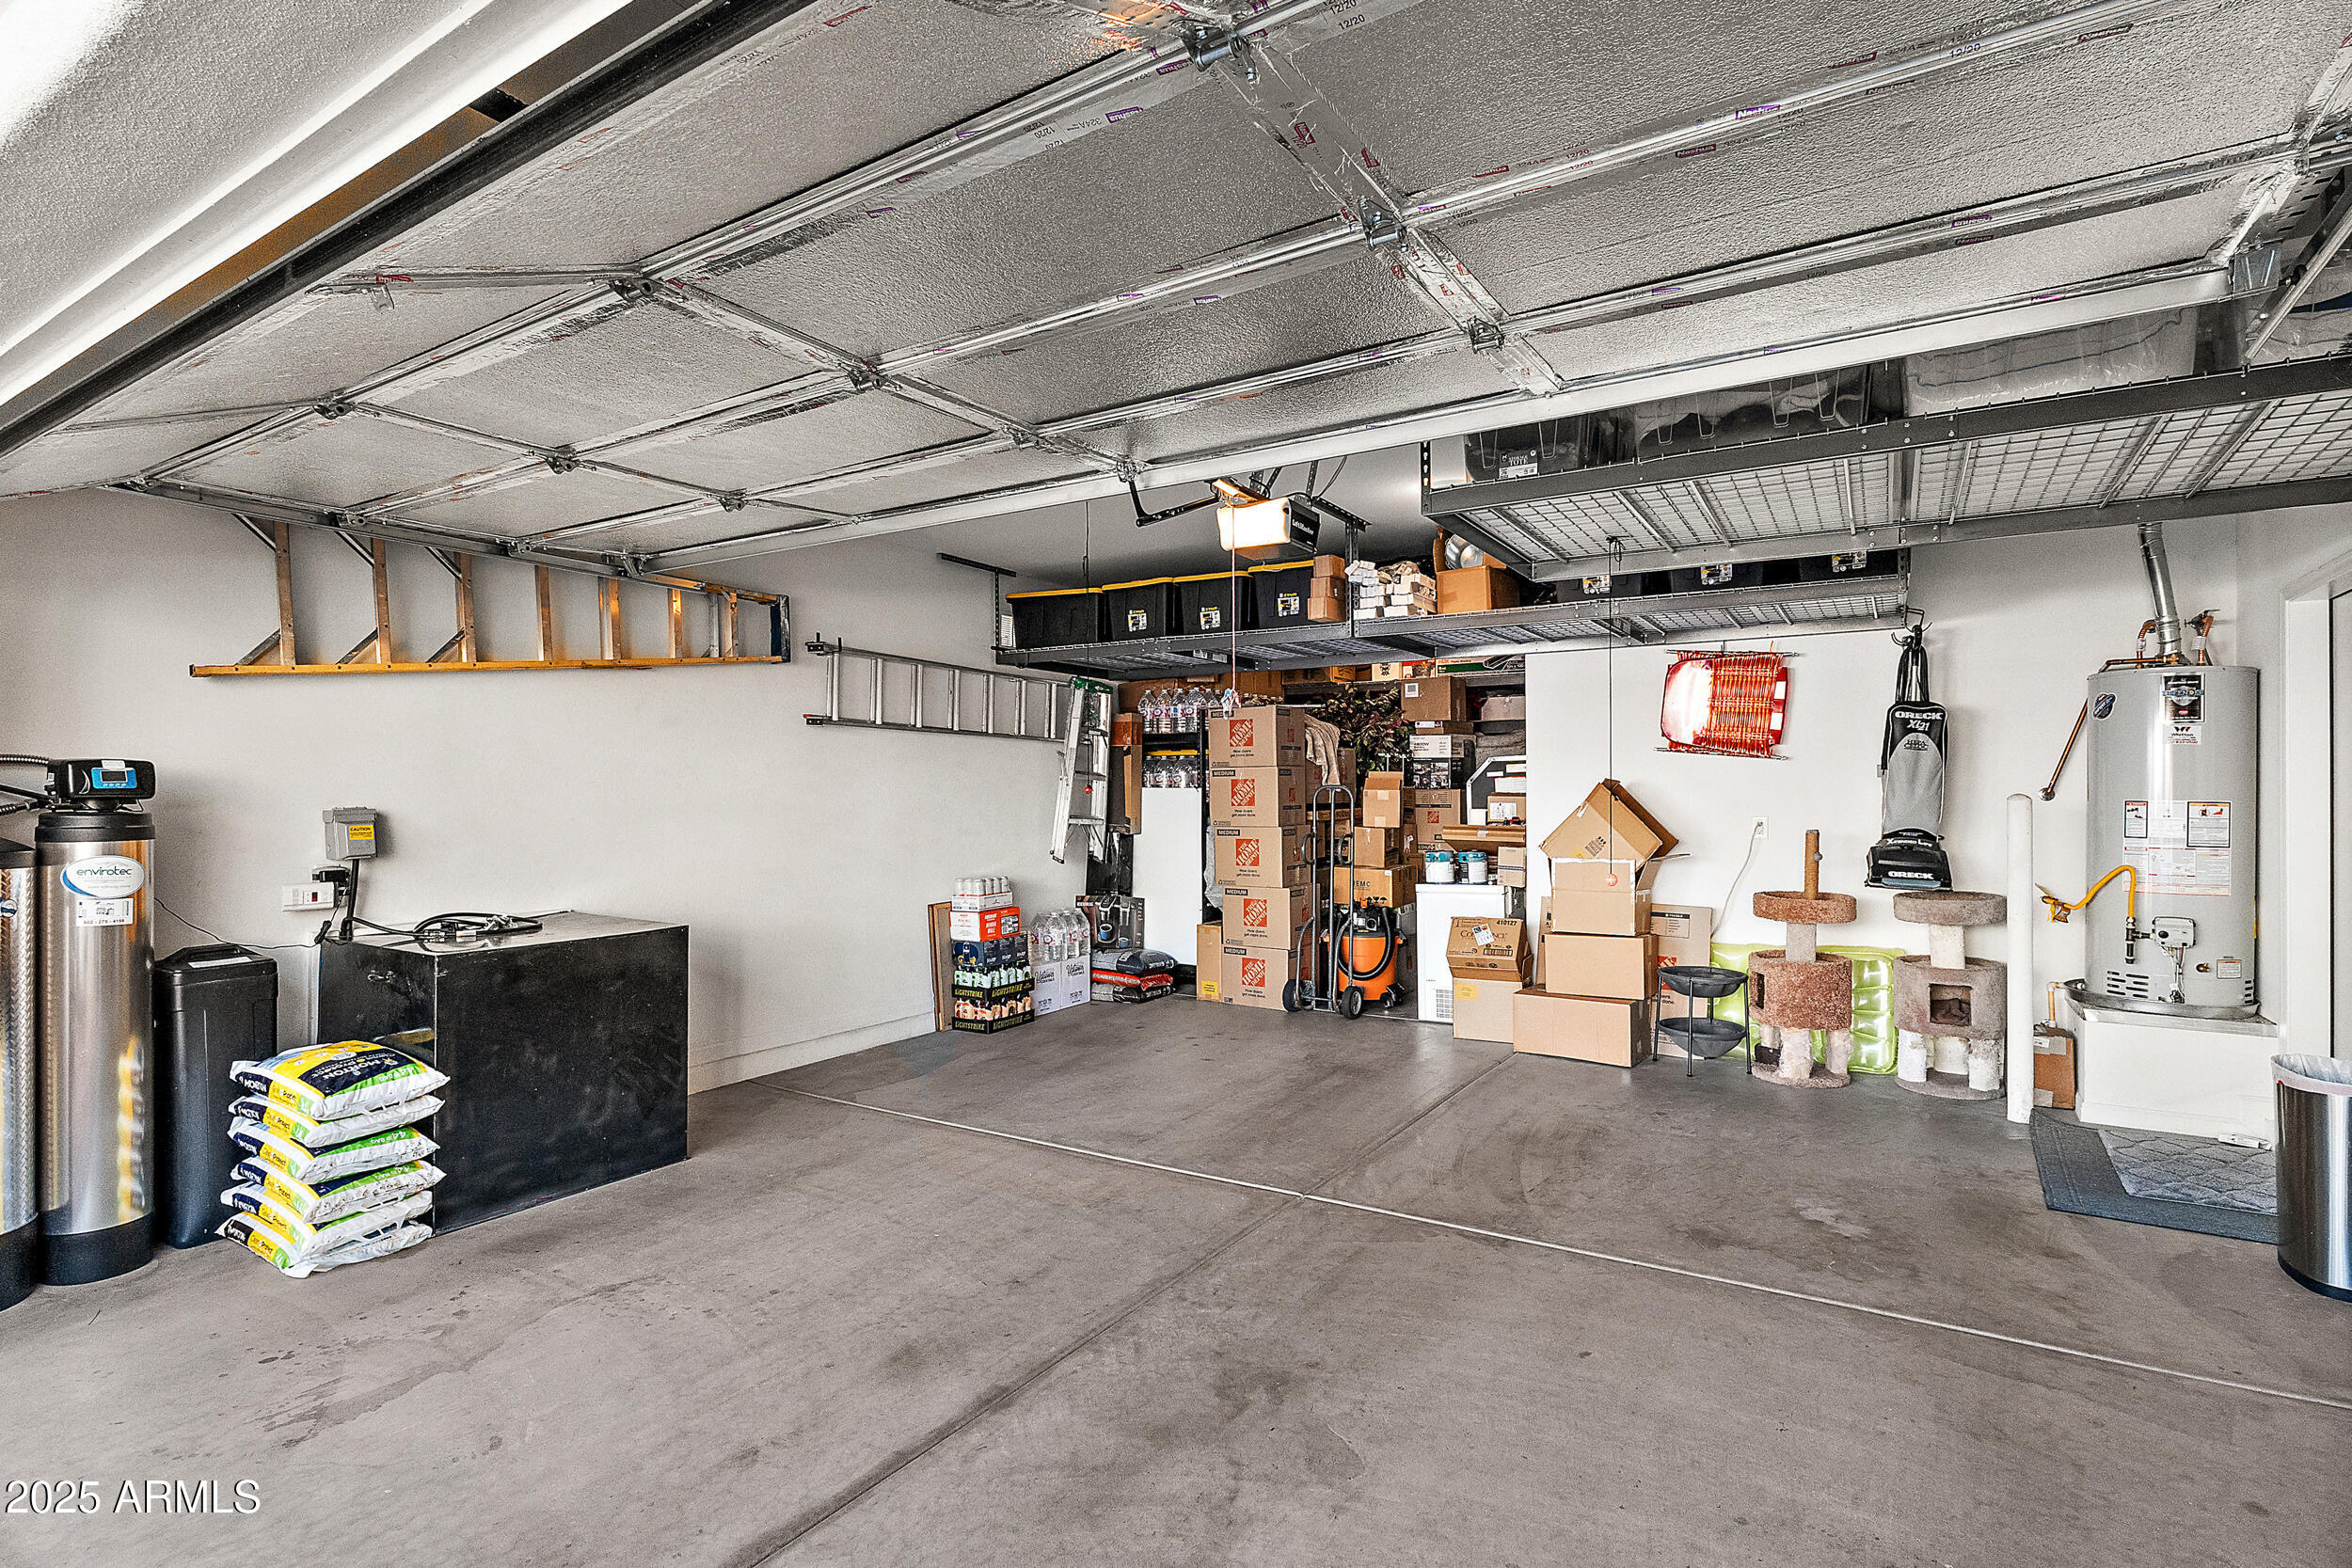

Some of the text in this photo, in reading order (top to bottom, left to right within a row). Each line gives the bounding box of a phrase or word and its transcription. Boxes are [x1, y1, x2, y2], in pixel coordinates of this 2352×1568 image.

[1338, 14, 1366, 30] 12/20
[1950, 43, 1981, 58] 12/20
[1034, 126, 1056, 139] 12/20
[1895, 711, 1943, 720] ORECK
[76, 866, 132, 876] envirotec
[1888, 871, 1934, 879] ORECK
[323, 1058, 381, 1079] MORTON
[392, 1131, 406, 1140] 44
